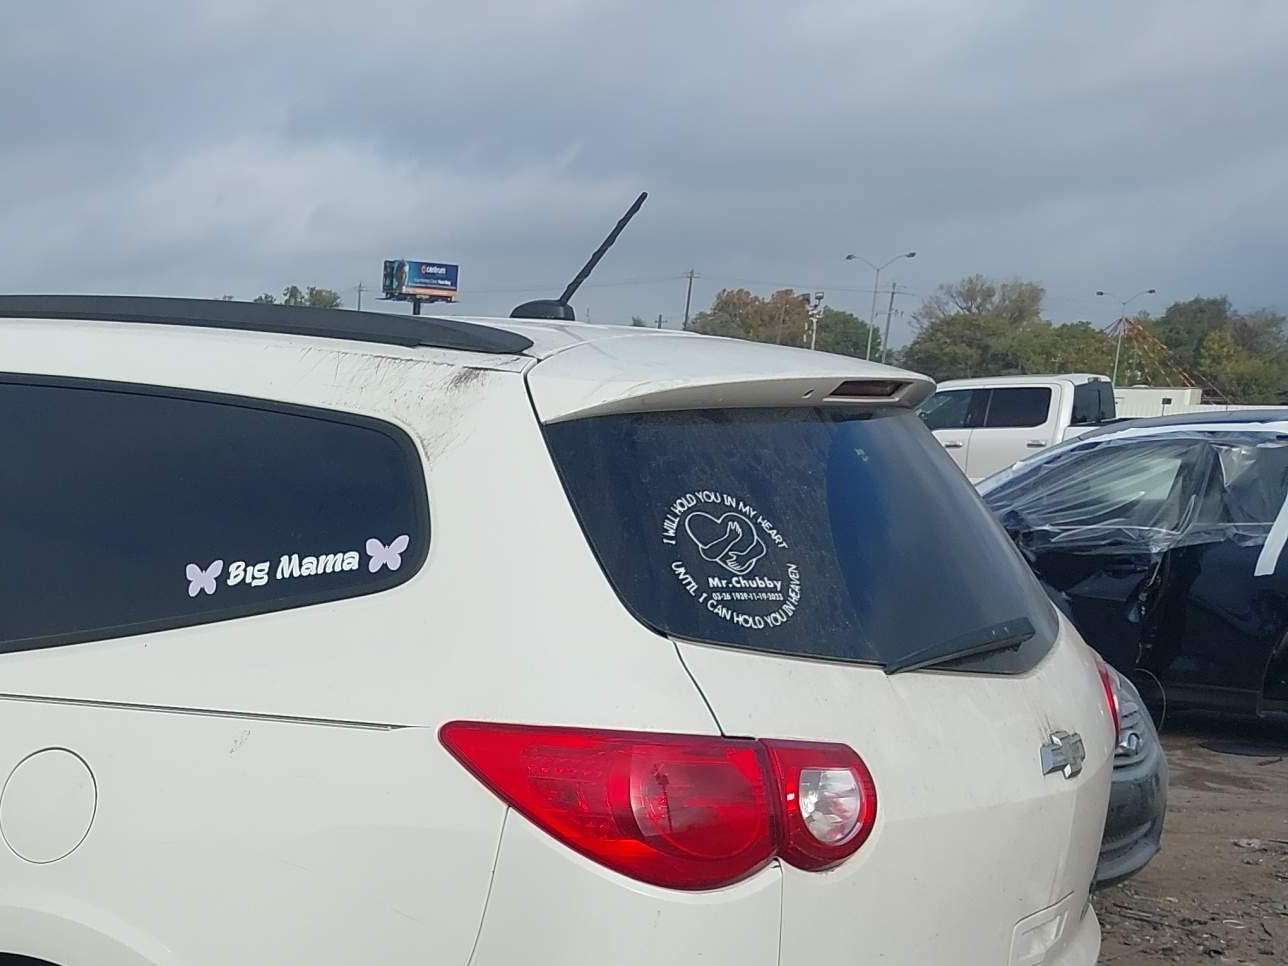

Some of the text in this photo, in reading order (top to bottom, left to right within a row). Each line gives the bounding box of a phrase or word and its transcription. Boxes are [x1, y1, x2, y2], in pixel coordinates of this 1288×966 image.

[663, 490, 789, 550] I WILL HOLD YOU IN MY HEART
[226, 551, 360, 587] Big Mama
[671, 561, 801, 628] UNTIL I CAN HOLD YOU IN HEAVEN
